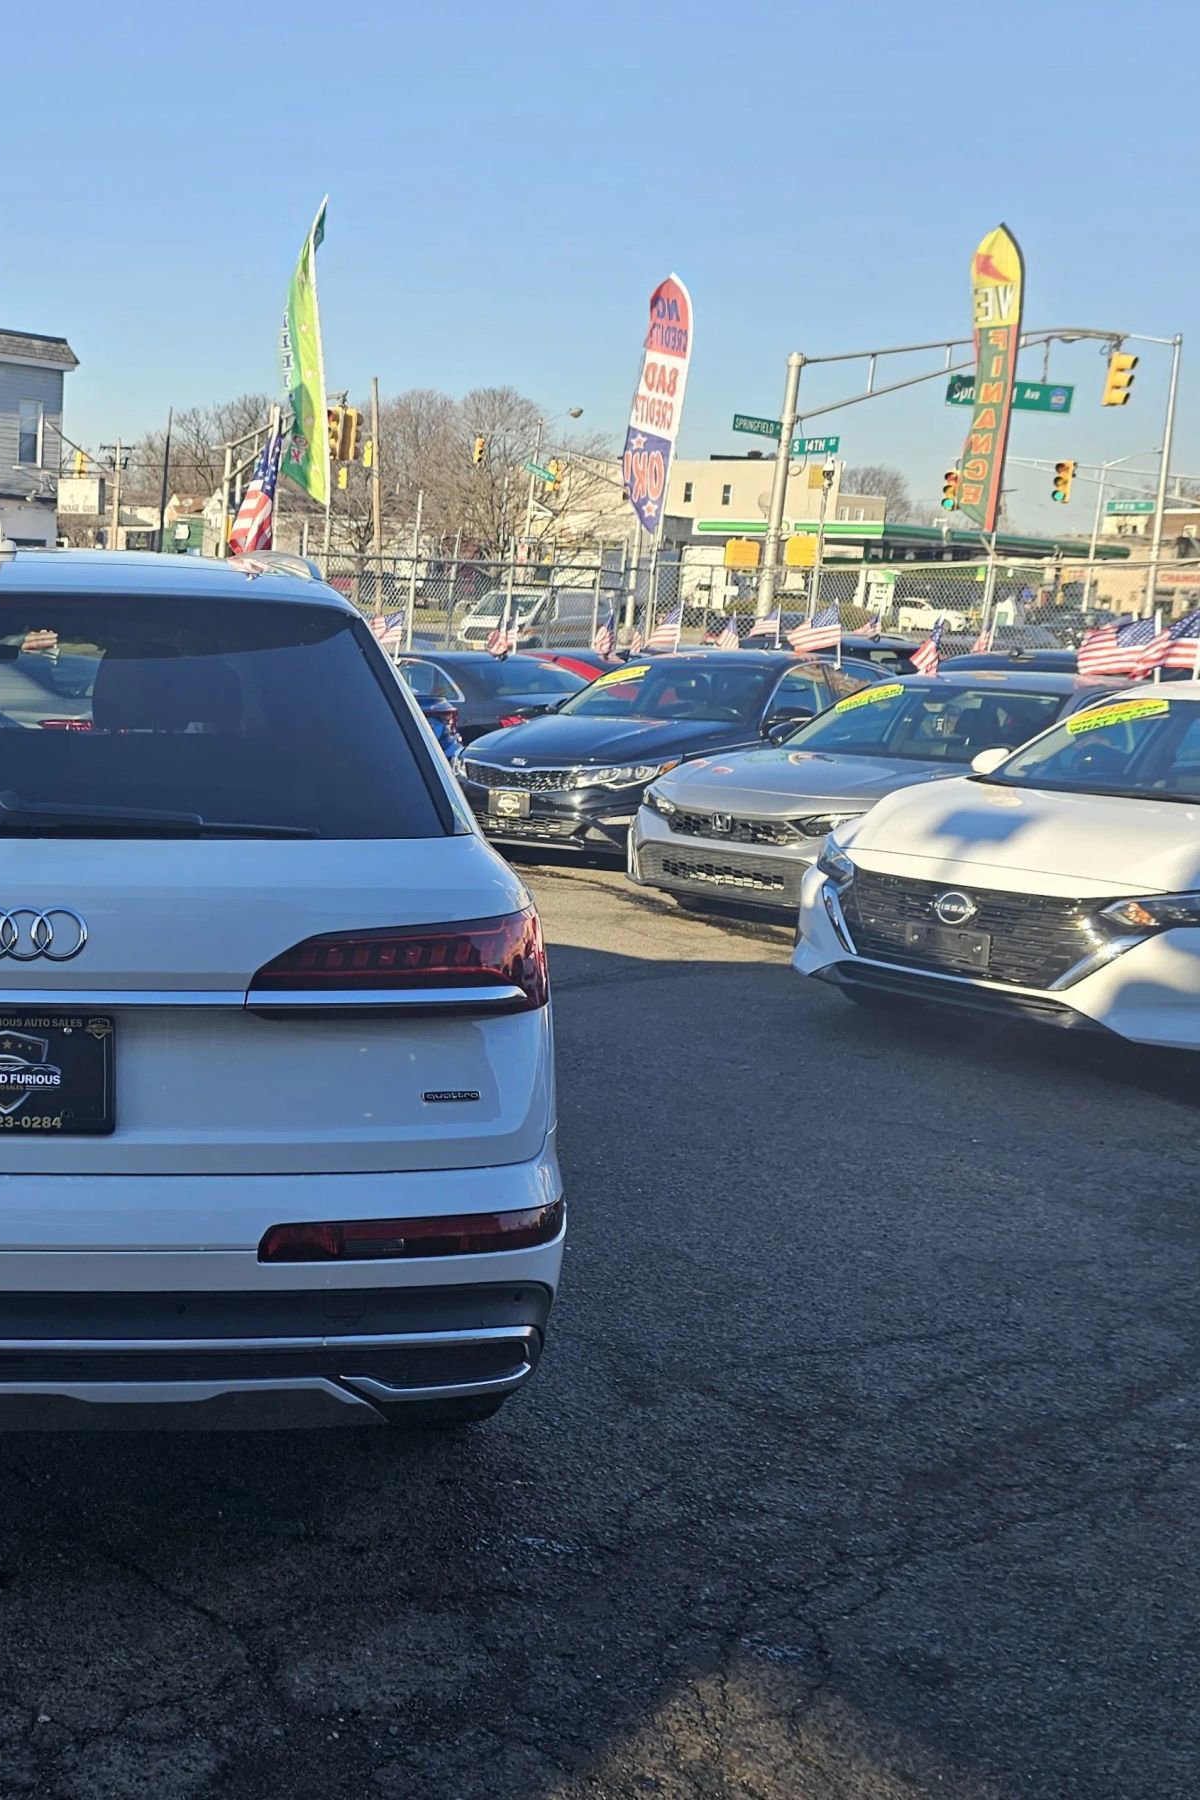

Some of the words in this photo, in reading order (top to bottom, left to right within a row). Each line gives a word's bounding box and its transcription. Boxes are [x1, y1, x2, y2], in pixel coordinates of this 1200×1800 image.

[1023, 388, 1041, 400] Ave
[734, 417, 775, 435] SPRINGFIELD
[793, 440, 800, 453] S
[804, 438, 826, 452] 14TH
[933, 901, 978, 915] NISSAN
[24, 1018, 50, 1028] AUTO
[52, 1019, 82, 1028] SALES
[9, 1073, 61, 1085] FURIOUS
[425, 1092, 479, 1100] quattro
